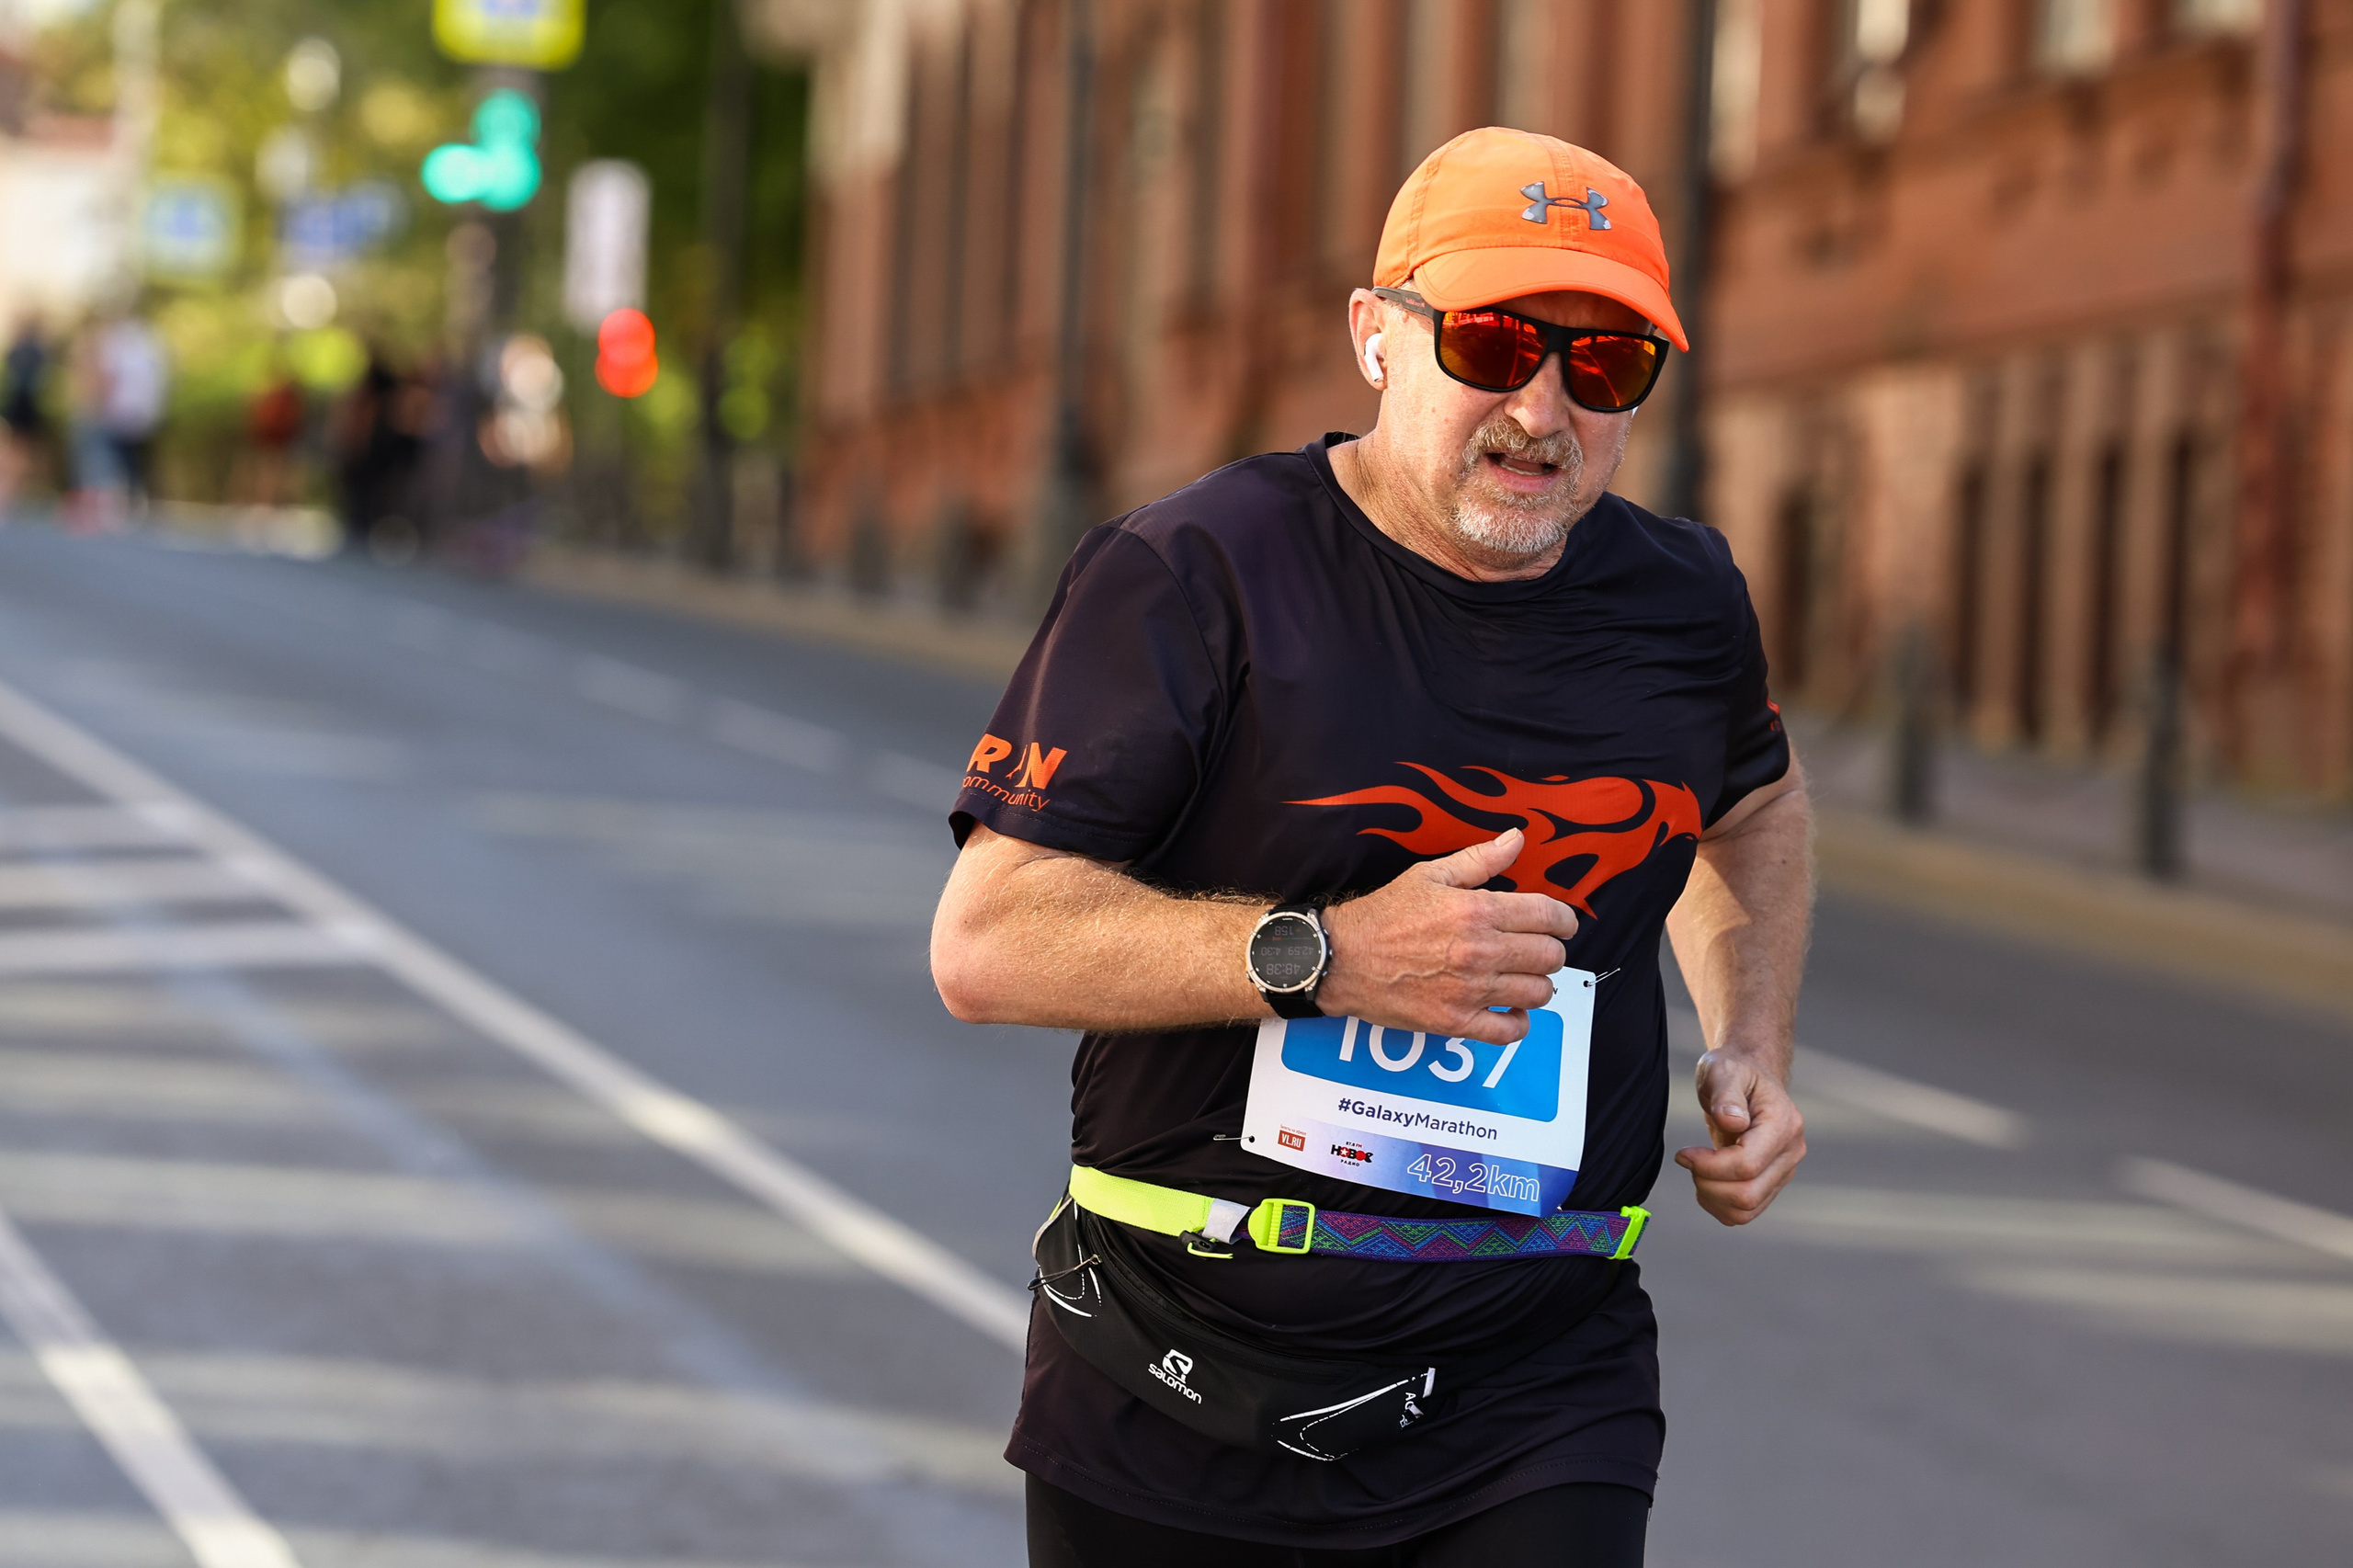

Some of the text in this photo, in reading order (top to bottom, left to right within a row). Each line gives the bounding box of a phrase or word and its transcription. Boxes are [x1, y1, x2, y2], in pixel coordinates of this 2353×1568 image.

[962, 776, 1051, 812] ommunity
[1275, 926, 1293, 936] 158
[1338, 1097, 1497, 1141] #GalaxyMarathon
[1407, 1153, 1540, 1202] 42,2km
